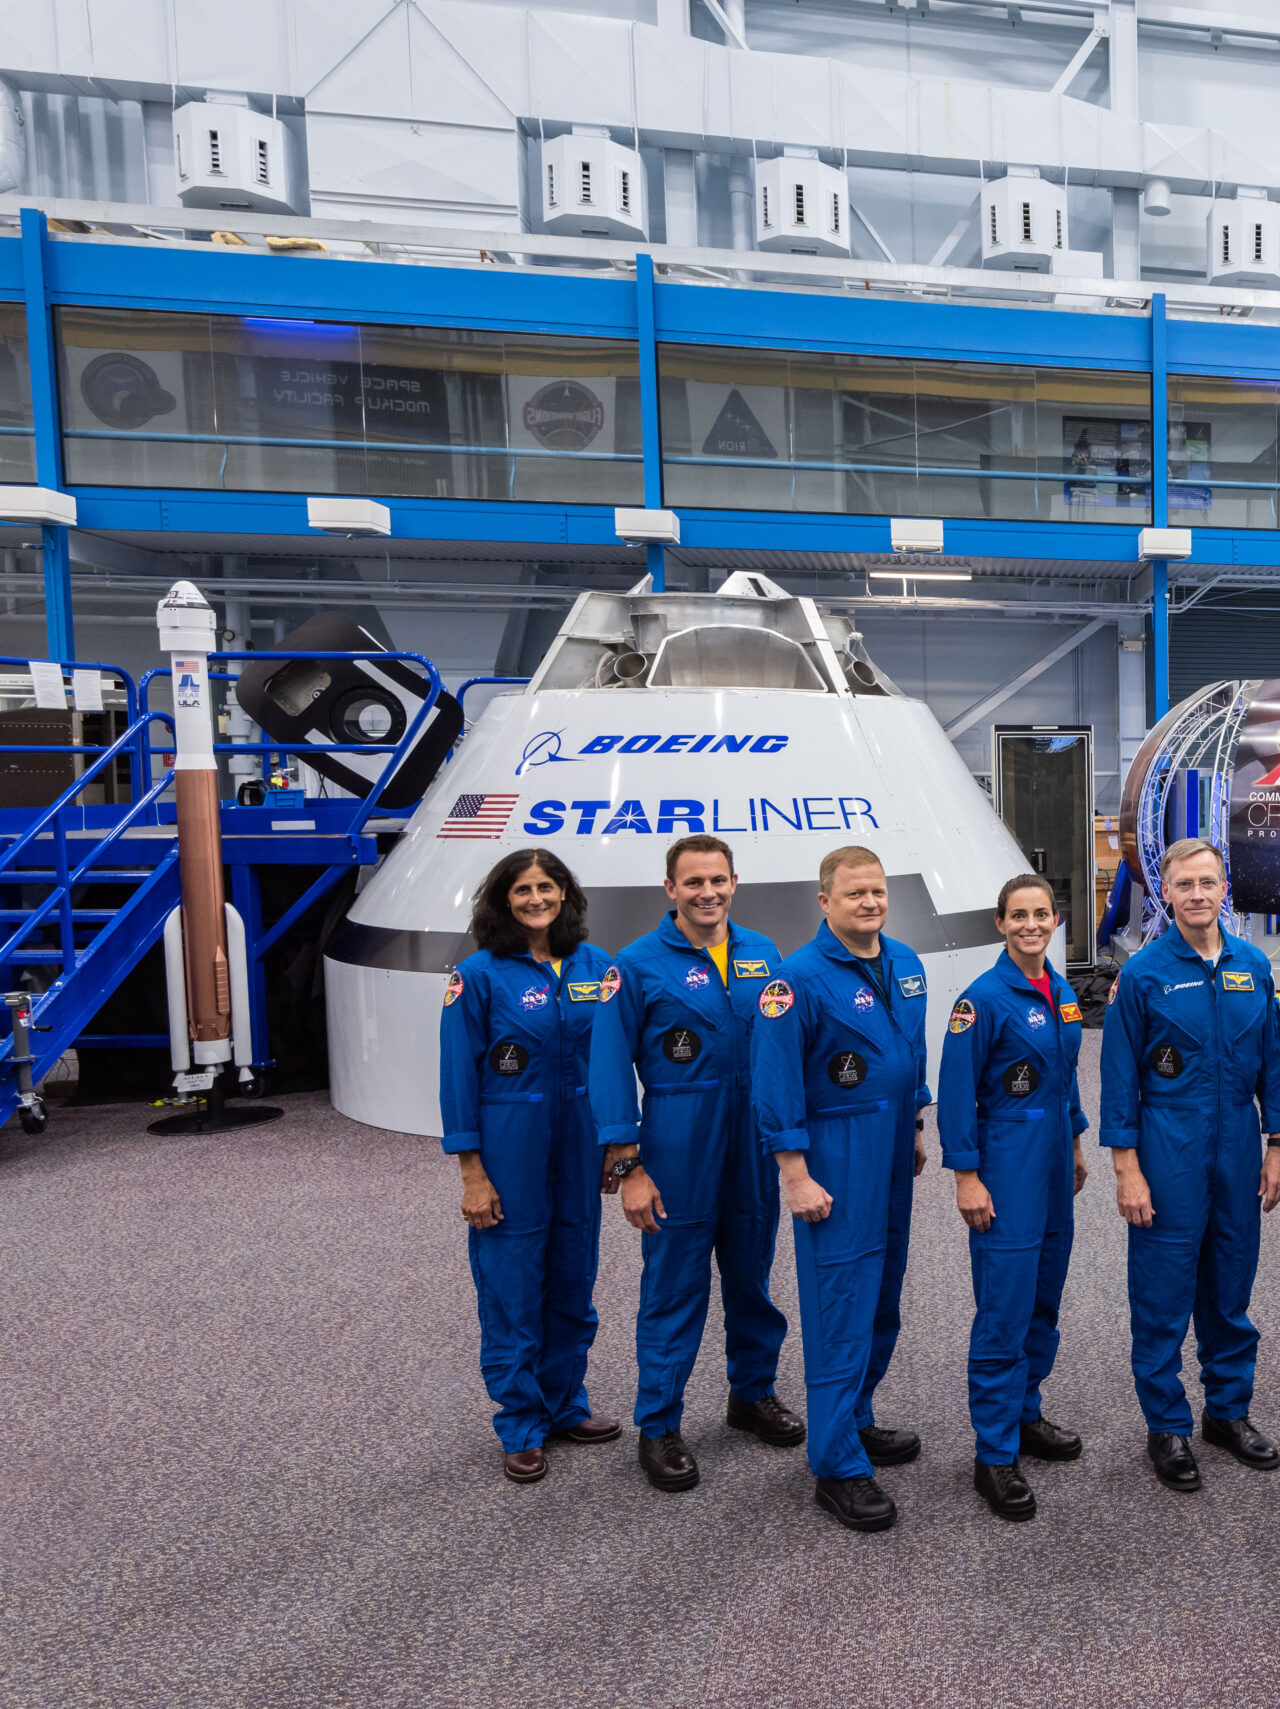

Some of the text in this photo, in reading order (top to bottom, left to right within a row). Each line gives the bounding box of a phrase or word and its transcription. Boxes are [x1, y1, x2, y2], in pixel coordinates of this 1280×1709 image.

[577, 734, 790, 754] BOEING
[523, 797, 880, 836] STARLINER
[686, 973, 709, 983] NASA
[1174, 980, 1204, 990] BOEING
[522, 993, 547, 1004] NASA
[854, 995, 874, 1004] NASA
